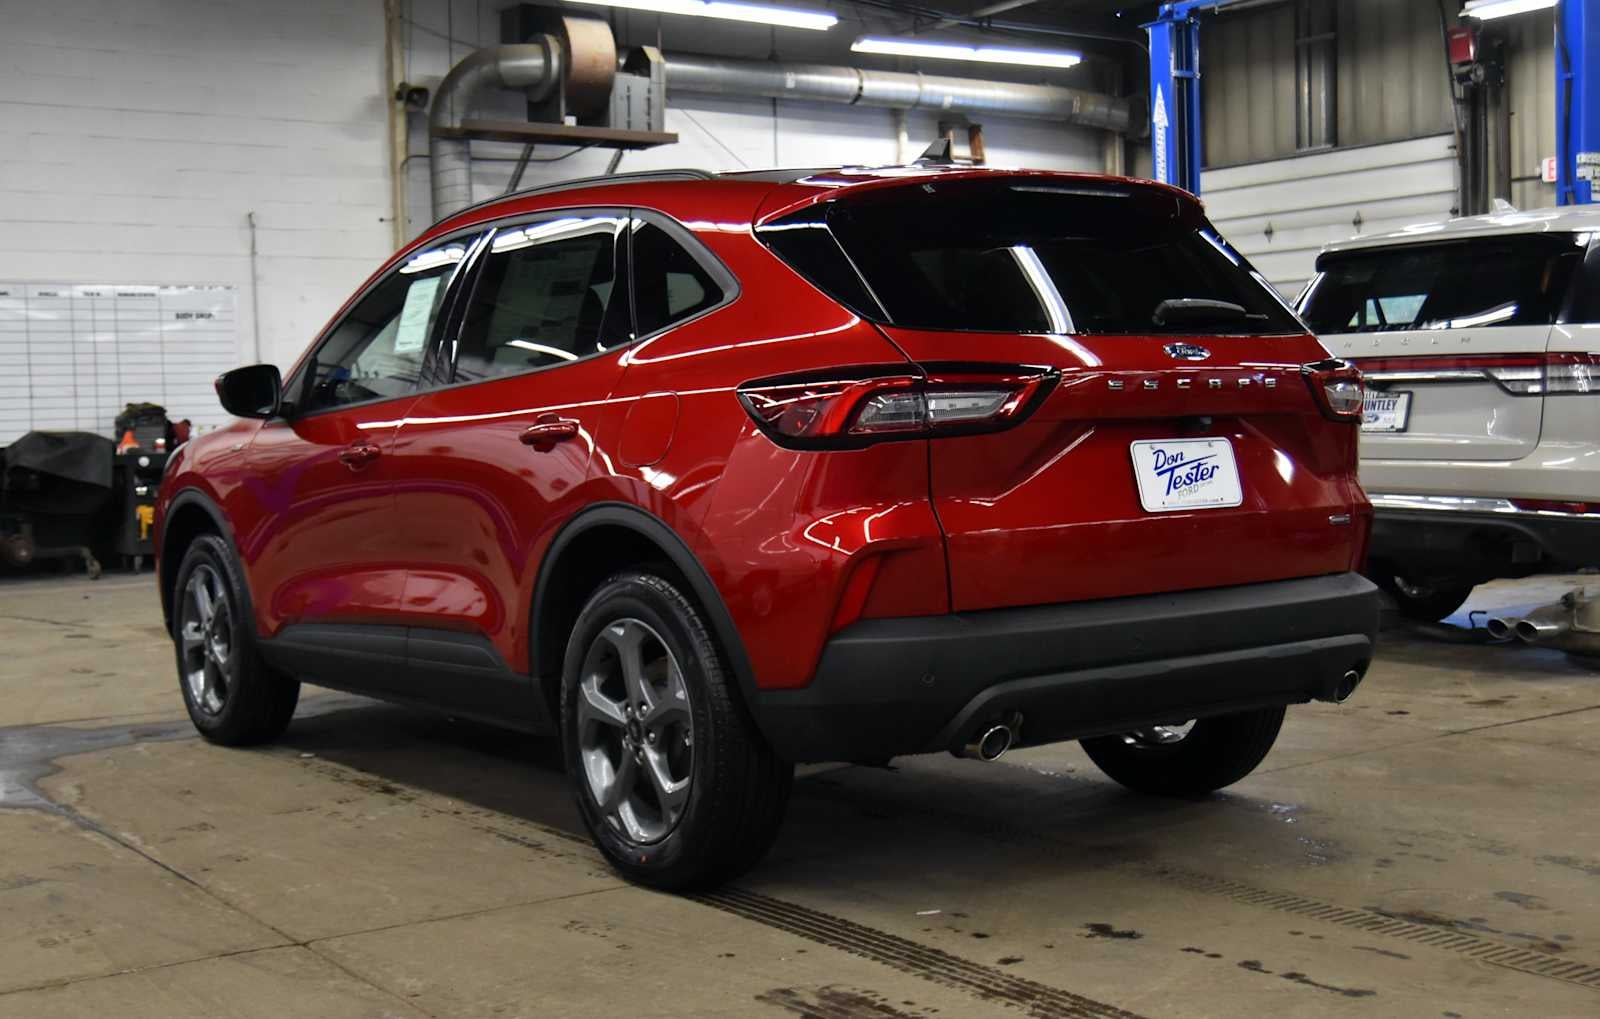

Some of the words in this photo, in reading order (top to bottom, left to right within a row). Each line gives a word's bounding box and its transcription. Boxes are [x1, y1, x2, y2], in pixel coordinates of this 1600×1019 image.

[1343, 336, 1471, 348] NCOLN
[1107, 378, 1277, 390] ESCAPE
[1363, 399, 1398, 411] UNTLEY
[1152, 449, 1184, 471] Don
[1156, 454, 1220, 496] Tester
[1178, 484, 1199, 496] FORD
